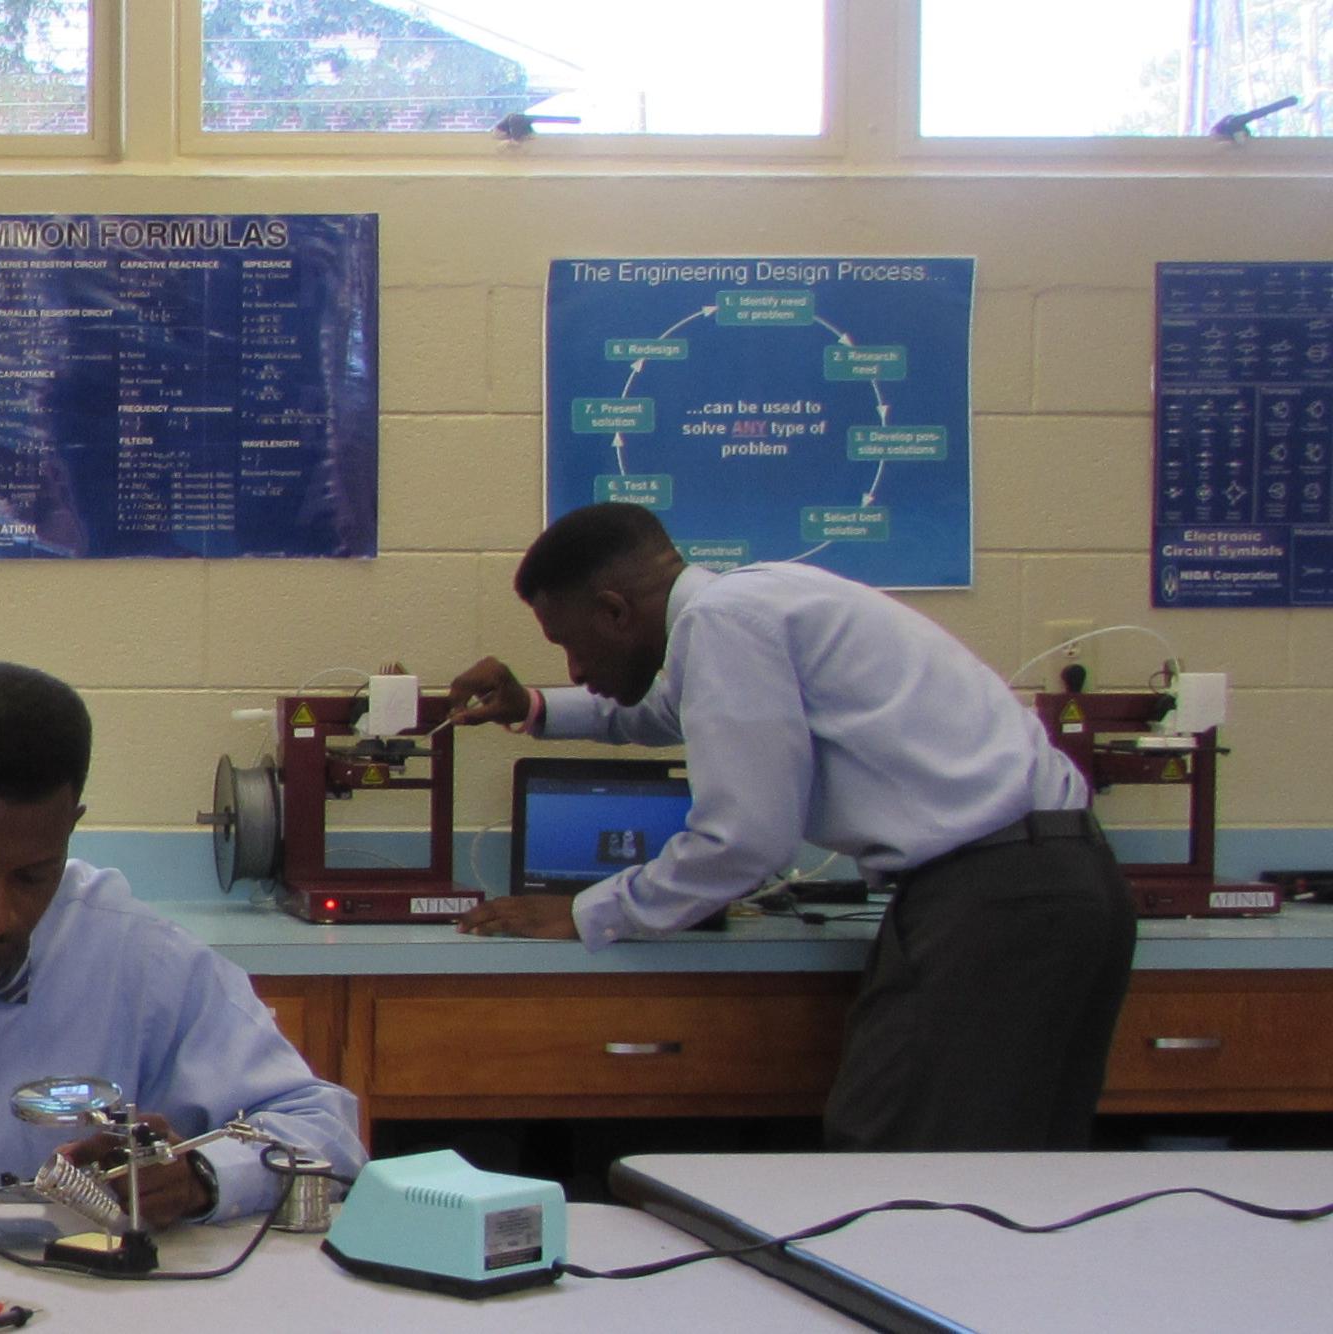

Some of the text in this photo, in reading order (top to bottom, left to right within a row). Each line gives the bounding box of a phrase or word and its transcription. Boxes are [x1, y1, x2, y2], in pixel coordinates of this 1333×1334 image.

[99, 220, 288, 250] FORMULAS
[30, 260, 73, 269] RESISTOR
[74, 260, 108, 269] CIRCUIT
[168, 260, 220, 269] REACTANCE
[242, 260, 292, 269] IMPEDANCE
[571, 262, 611, 283] The
[618, 262, 748, 287] Engineering
[756, 261, 830, 286] Design
[724, 296, 807, 308] 1. Identify need
[40, 309, 80, 318] RESISTOR
[82, 309, 113, 318] CIRCUIT
[751, 310, 795, 321] problem
[628, 344, 680, 357] Redesign
[833, 351, 899, 361] 2. Research
[852, 364, 878, 375] need
[118, 405, 169, 414] FREQUENCY
[585, 403, 643, 414] 7. Present
[686, 400, 821, 415] ...can be used to
[591, 417, 637, 427] solution
[682, 420, 828, 438] solve ANY type of
[119, 436, 154, 445] FILTERS
[869, 431, 914, 444] Develop
[241, 439, 300, 448] WAVELENGTH
[721, 441, 789, 459] problem
[857, 444, 936, 455] sible solutions
[624, 480, 648, 490] Test
[609, 493, 657, 504] Evaluate
[823, 511, 857, 522] Select
[859, 511, 882, 522] best
[823, 525, 868, 536] solution
[1183, 530, 1262, 542] Electronic
[688, 546, 743, 557] Construct
[1162, 544, 1284, 559] Circuit Symbols
[1180, 570, 1279, 582] NIDA Corporation
